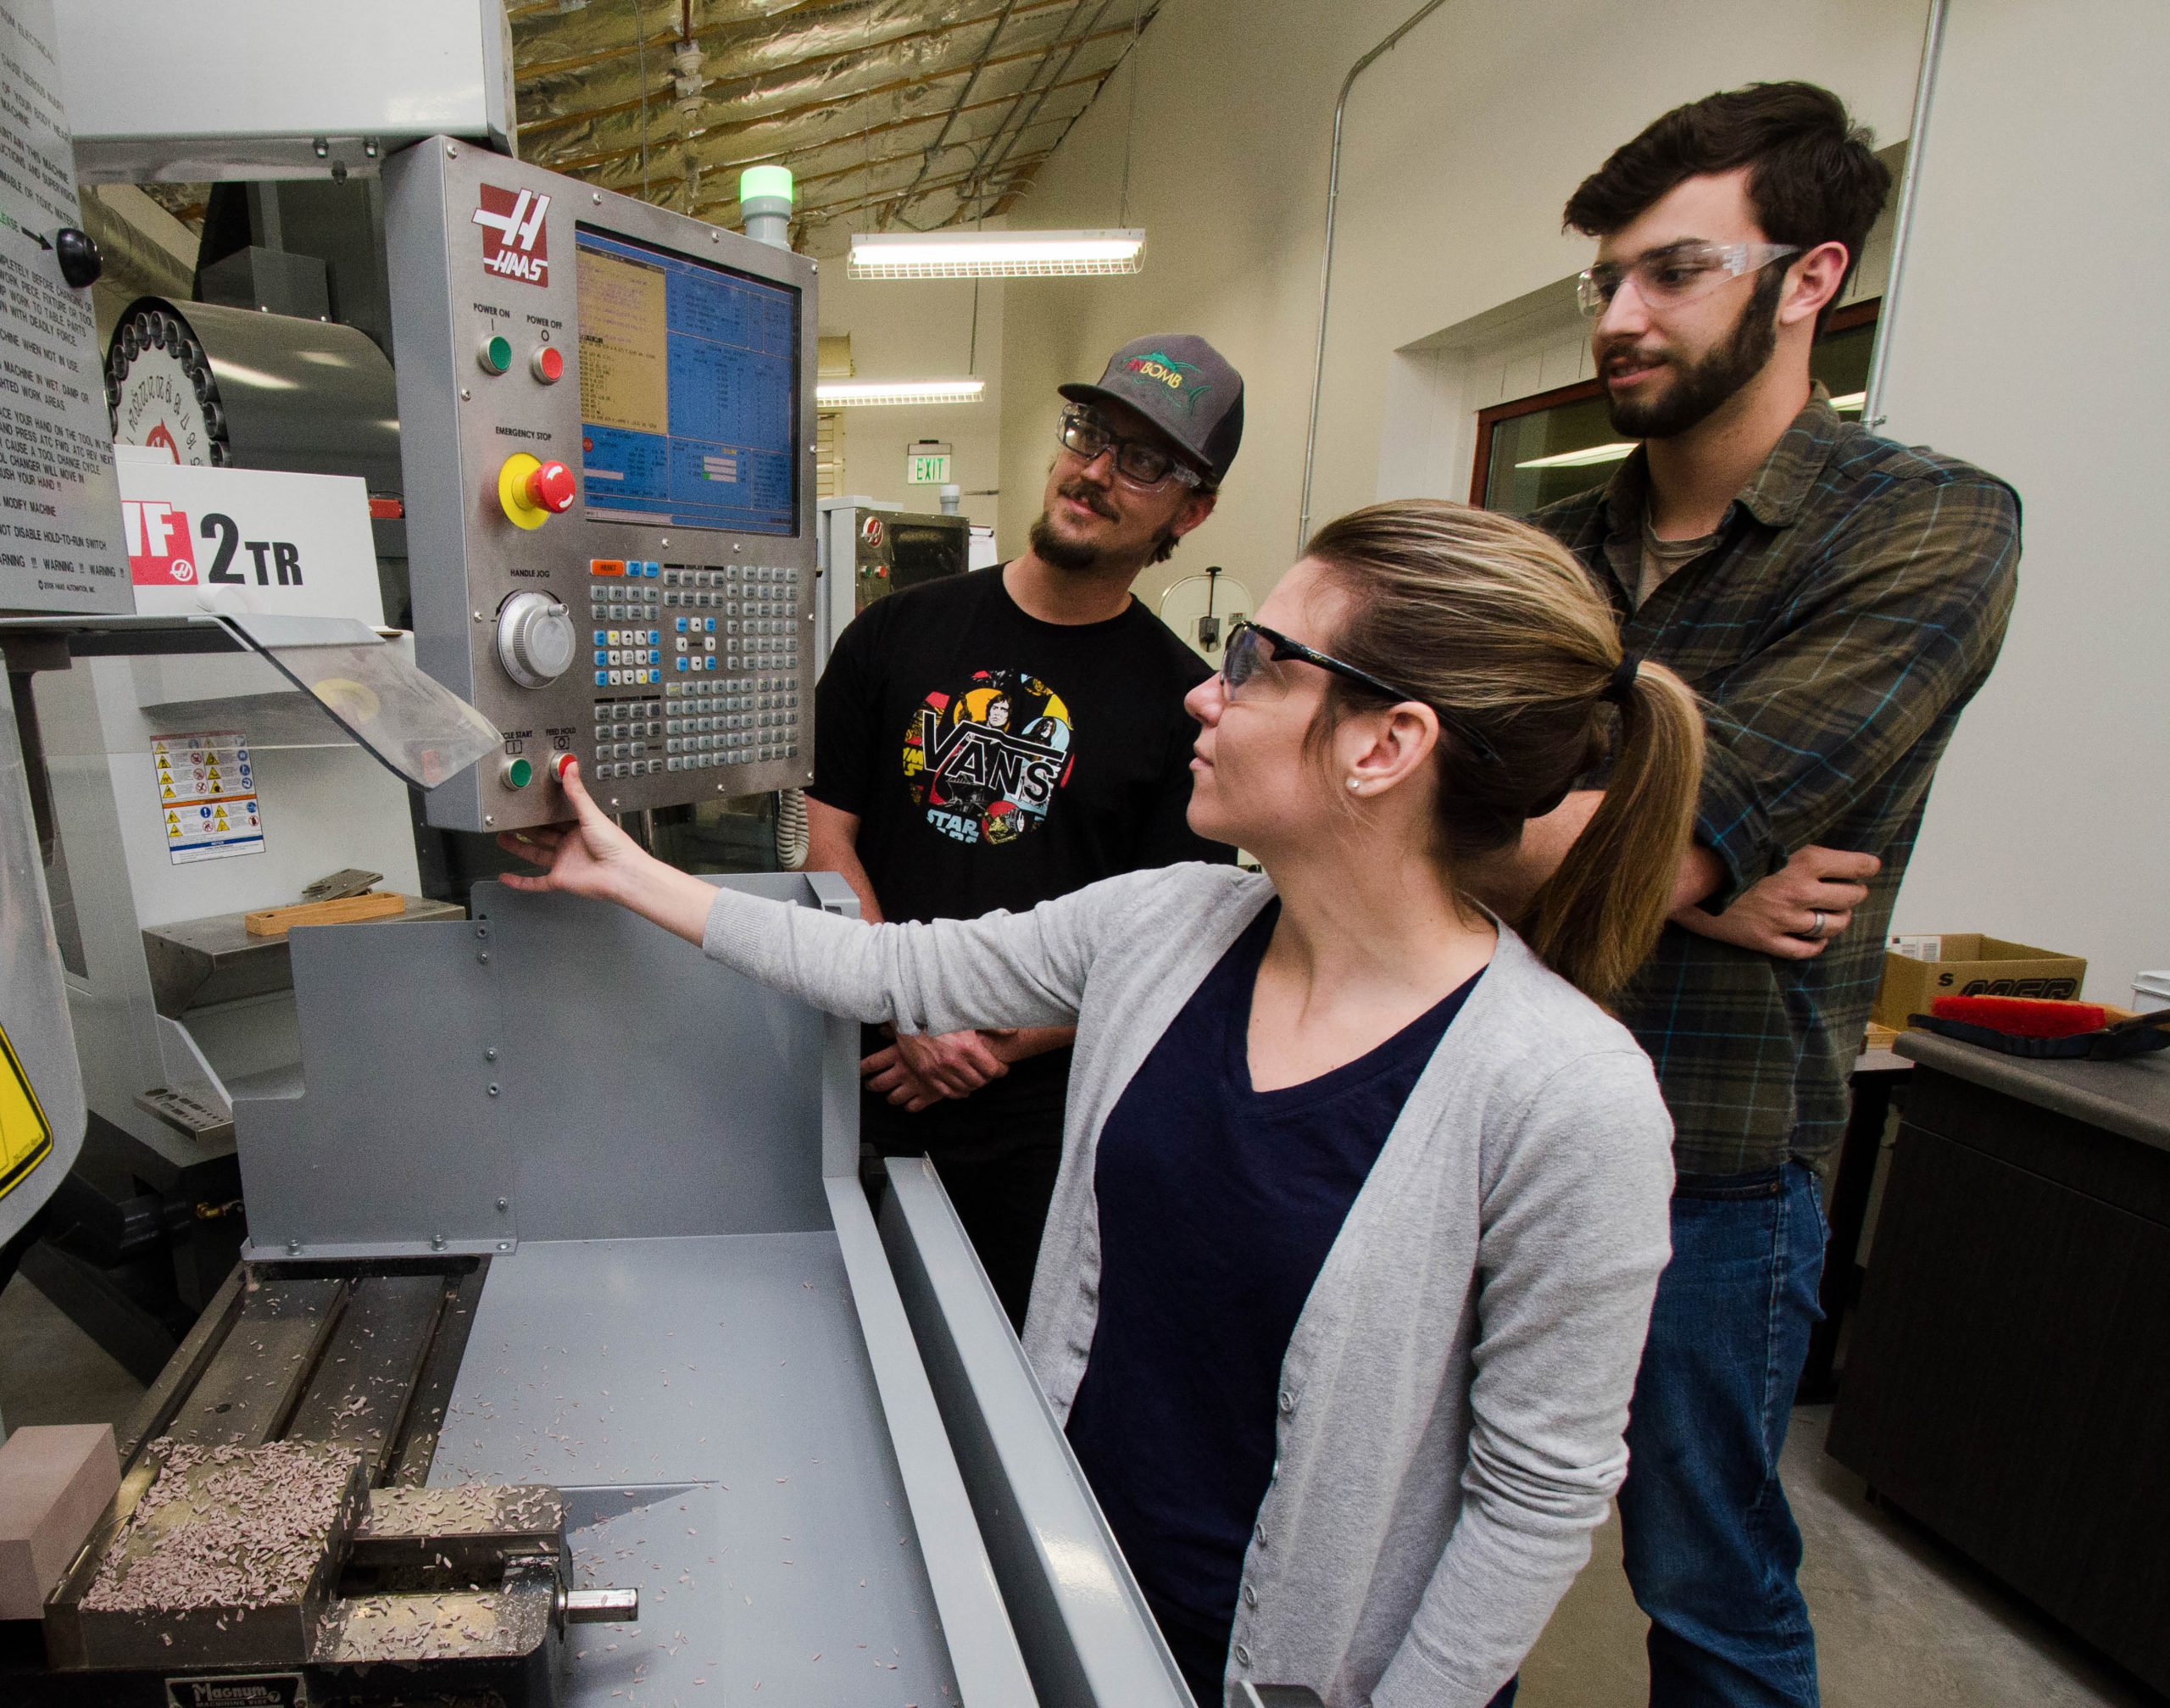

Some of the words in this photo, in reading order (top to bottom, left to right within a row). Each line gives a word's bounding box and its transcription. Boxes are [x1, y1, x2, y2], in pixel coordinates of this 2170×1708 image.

[14, 90, 32, 115] YOUR
[483, 249, 548, 281] HAAS
[31, 271, 54, 293] BEFORE
[8, 290, 31, 310] WORK
[32, 301, 42, 315] TO
[44, 308, 65, 327] TABLE
[66, 320, 86, 337] PARTS
[9, 304, 28, 324] WITH
[29, 314, 54, 337] DEADLY
[79, 312, 95, 329] TOOL
[473, 303, 497, 315] POWER
[498, 309, 510, 319] ON
[526, 314, 548, 327] POWER
[550, 320, 562, 330] OFF
[22, 338, 42, 358] WHEN
[43, 346, 56, 363] NOT
[58, 355, 65, 367] IN
[3, 360, 34, 382] MACHINE
[36, 373, 43, 387] IN
[62, 384, 79, 399] DAMP
[81, 392, 89, 404] OR
[21, 385, 42, 403] WORK
[14, 410, 33, 427] YOUR
[34, 418, 53, 434] HAND
[54, 425, 64, 437] ON
[64, 428, 77, 442] THE
[78, 433, 93, 448] TOOL
[95, 440, 101, 449] IN
[102, 441, 113, 453] THE
[495, 426, 535, 439] EMERGENCY
[537, 431, 552, 442] STOP
[5, 438, 28, 455] CAUSE
[31, 446, 36, 457] A
[37, 448, 56, 463] TOOL
[57, 453, 81, 470] CHANGE
[15, 426, 37, 443] PRESS
[40, 435, 53, 448] ATC
[73, 445, 85, 458] ATC
[99, 453, 114, 466] NEXT
[9, 454, 42, 472] CHANGER
[42, 464, 58, 477] WILL
[59, 468, 77, 482] MOVE
[78, 474, 85, 484] IN
[17, 471, 36, 486] YOUR
[37, 476, 55, 490] HAND
[915, 458, 943, 481] EXIT
[3, 496, 27, 510] MODIFY
[29, 501, 57, 517] MACHINE
[14, 526, 42, 541] DISABLE
[43, 531, 85, 548] HOLD-TO-RUN
[86, 538, 107, 551] SWITCH
[42, 559, 75, 573] WARNING
[89, 565, 116, 577] WARNING
[510, 569, 535, 577] HANDLE
[922, 709, 1067, 803] VANS
[926, 809, 979, 837] STAR
[1938, 972, 1954, 987] S
[192, 1683, 267, 1701] Magnum
